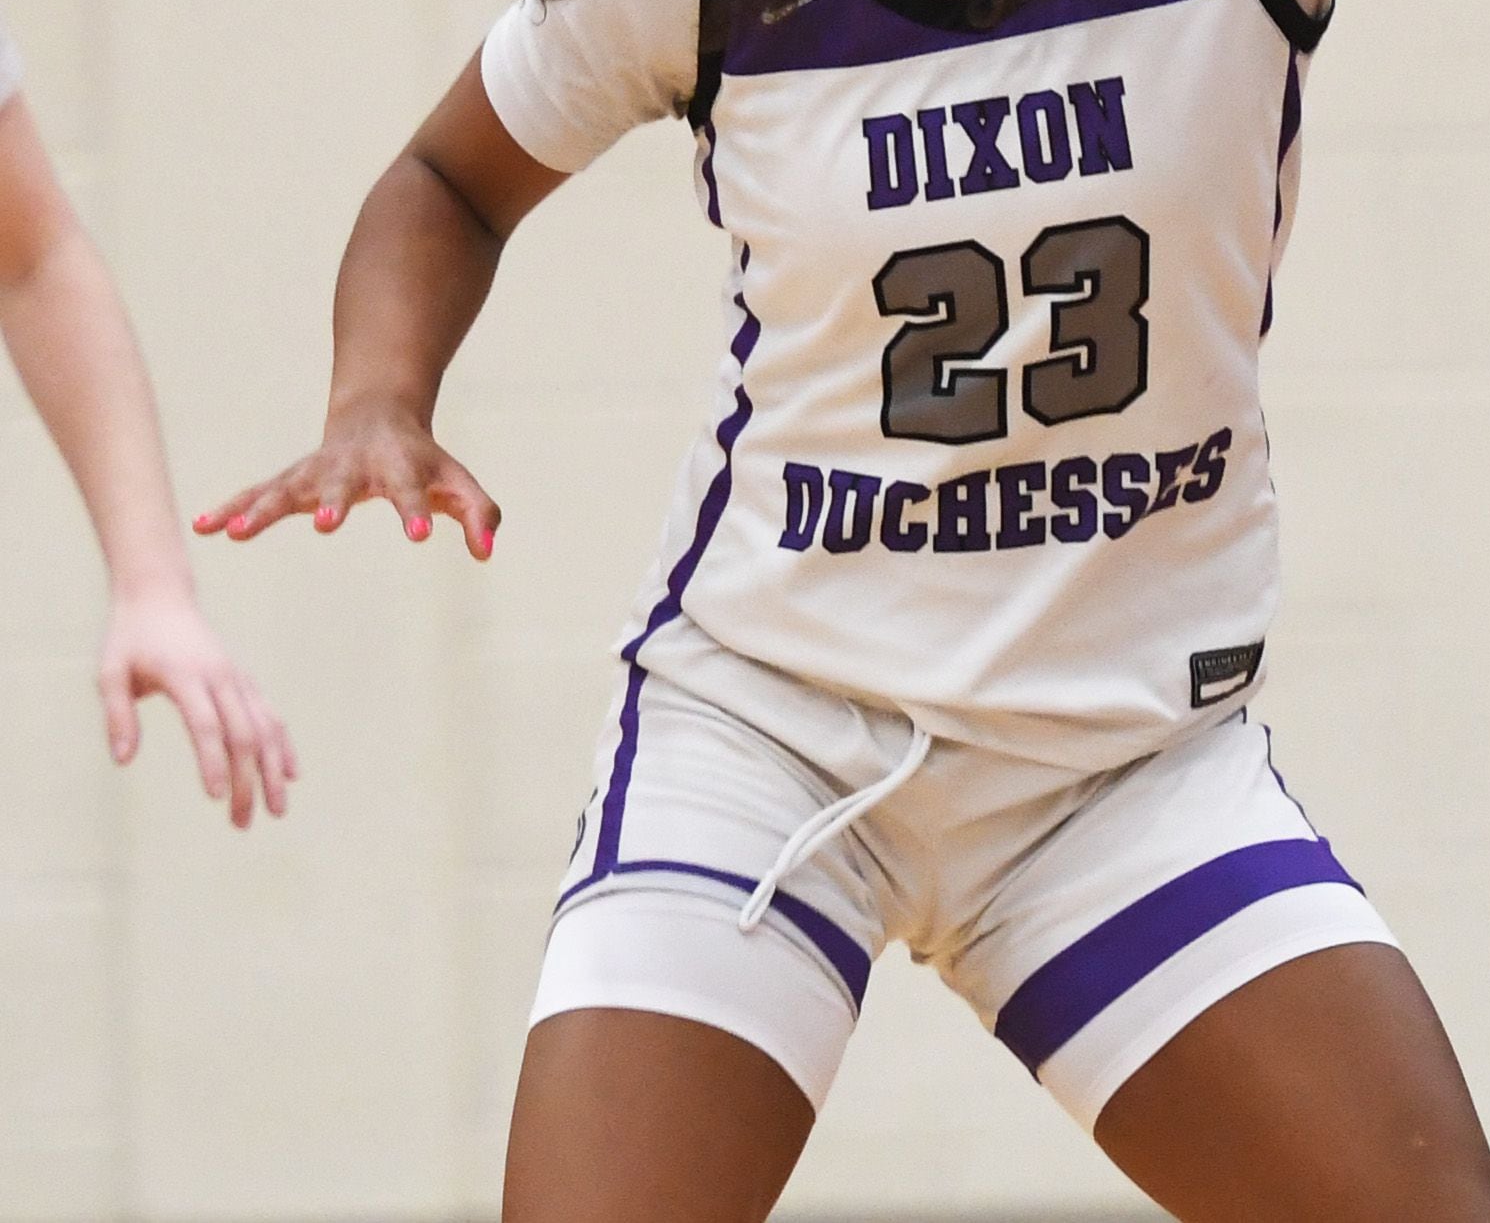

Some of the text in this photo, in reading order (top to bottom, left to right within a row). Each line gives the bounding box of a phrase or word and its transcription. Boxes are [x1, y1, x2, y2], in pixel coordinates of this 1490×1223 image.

[861, 75, 1134, 211] DIXON
[871, 214, 1151, 446] 23
[777, 425, 1234, 555] DUCHESSES
